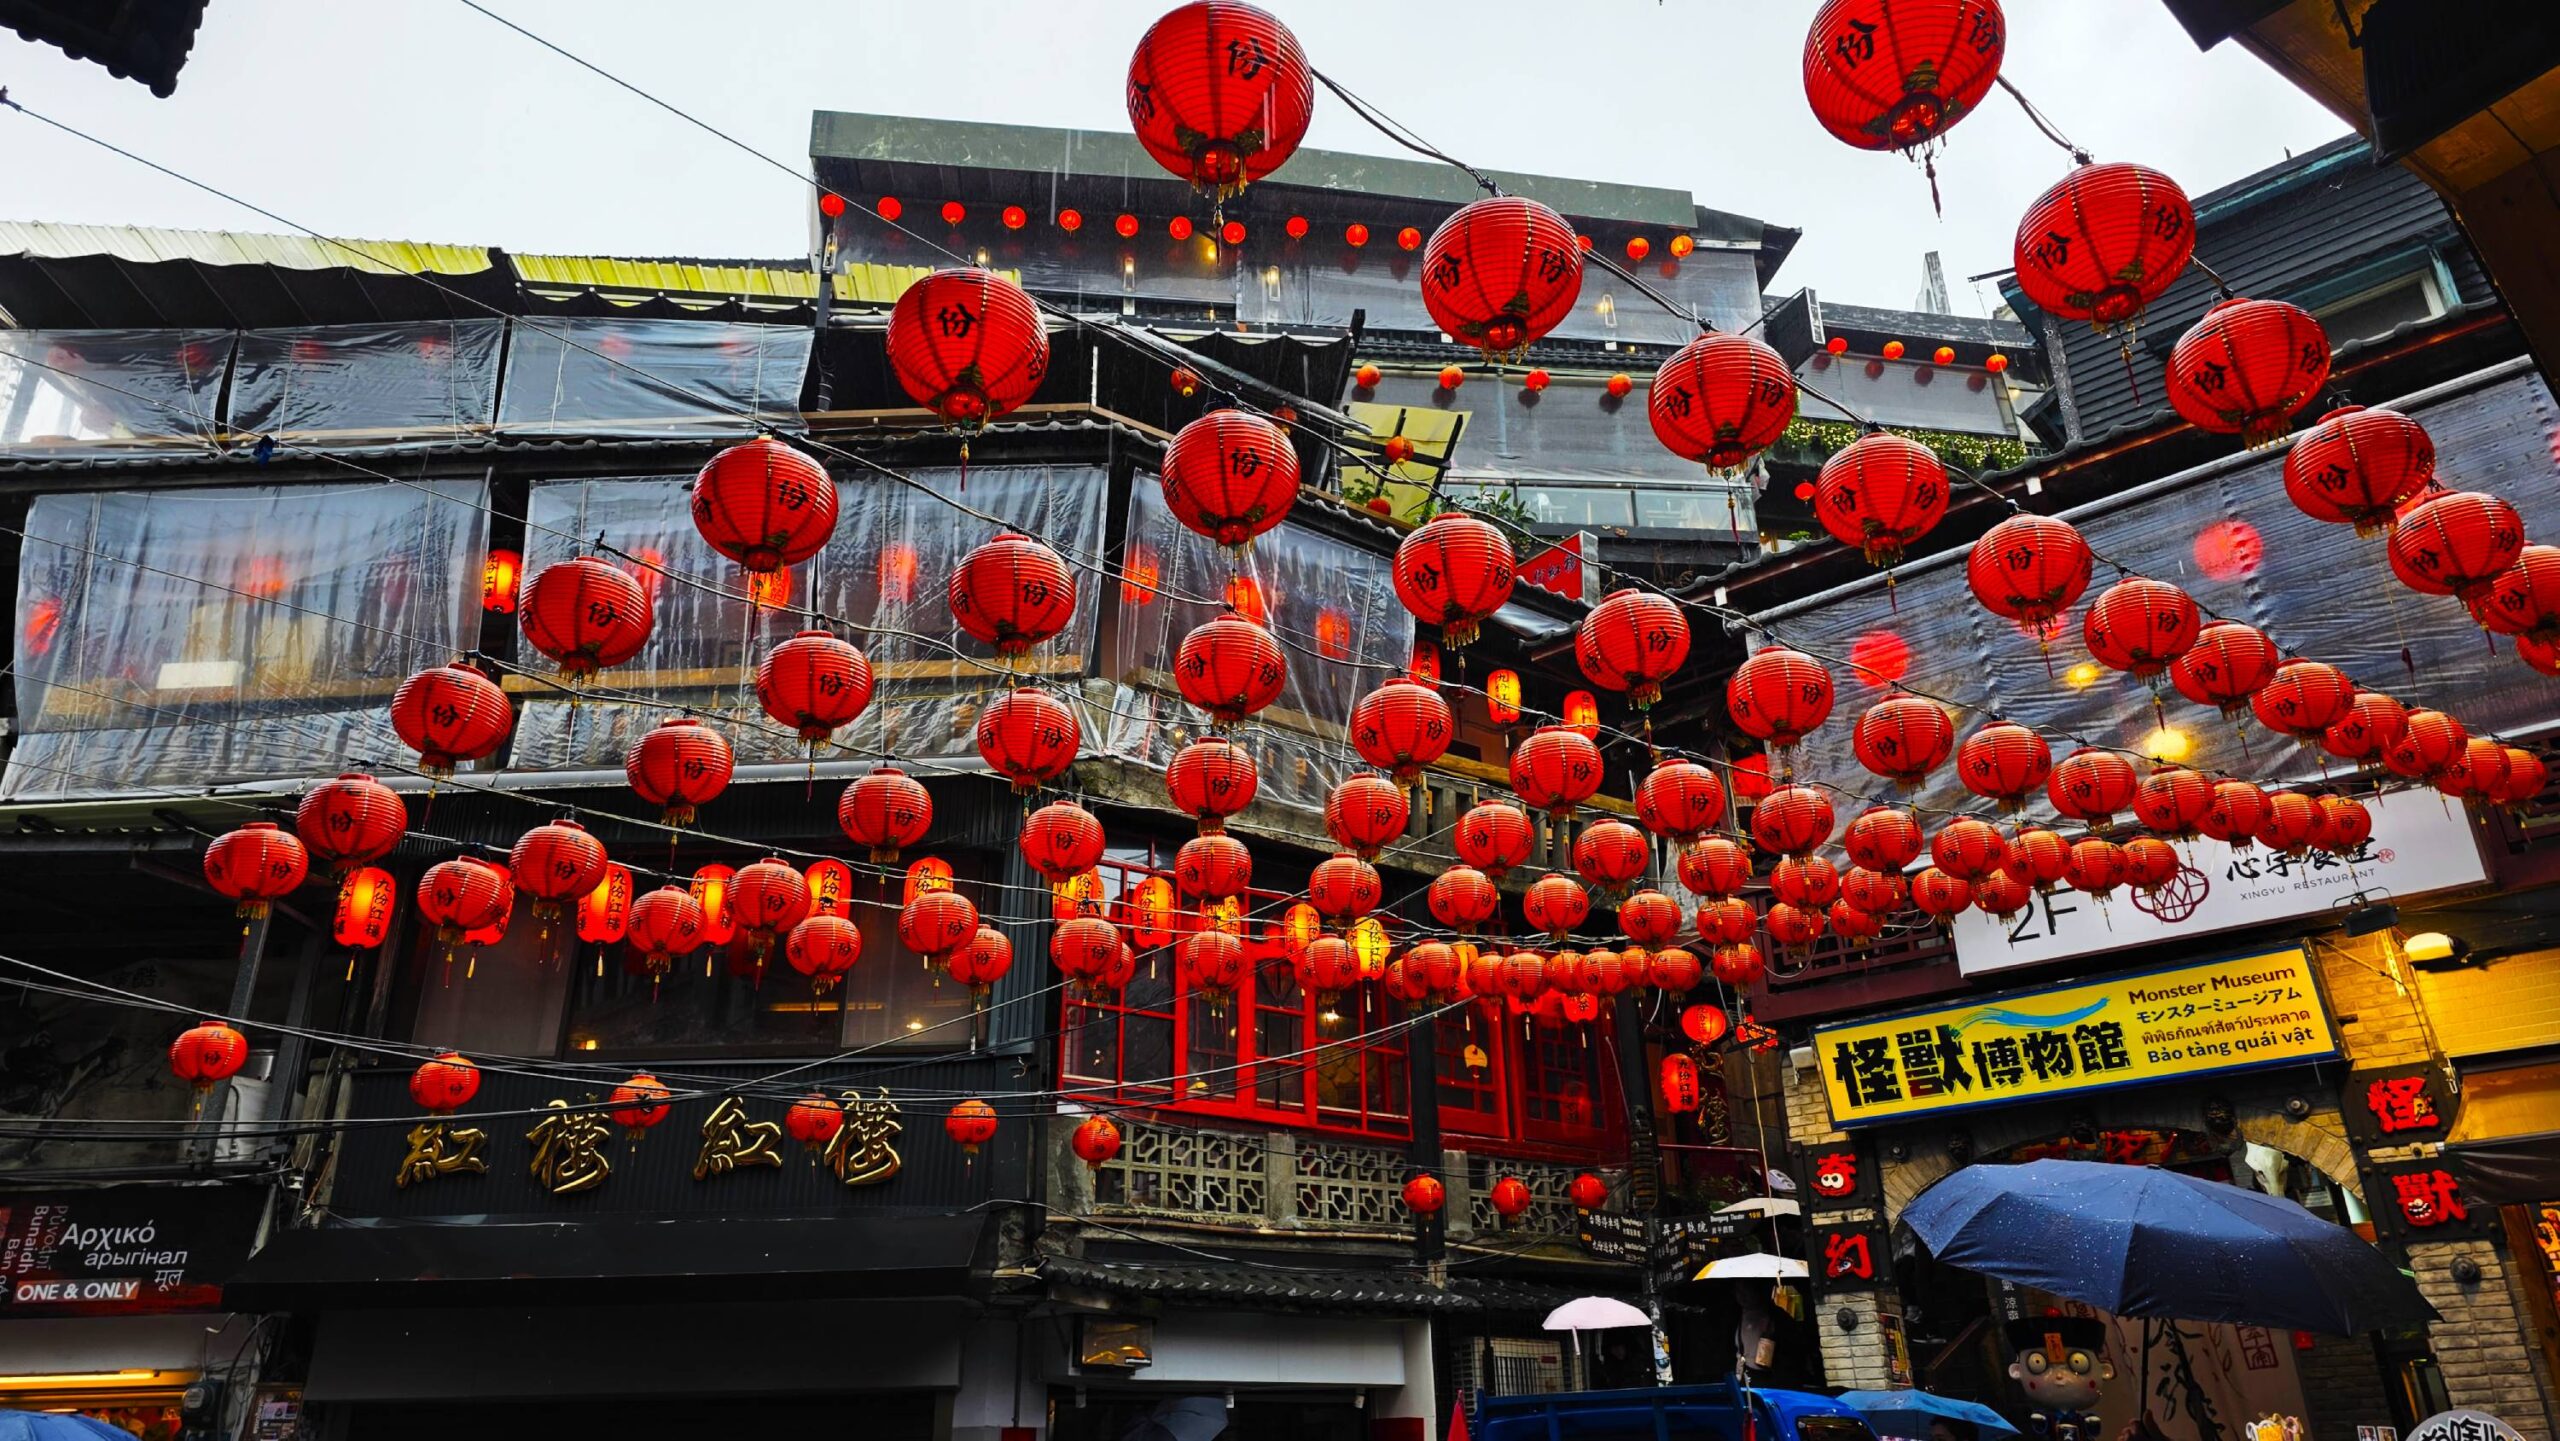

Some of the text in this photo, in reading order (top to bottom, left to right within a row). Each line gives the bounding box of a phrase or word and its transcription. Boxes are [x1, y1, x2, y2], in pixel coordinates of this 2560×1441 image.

[1835, 18, 1878, 70] 份
[1225, 37, 1269, 81] 份
[2153, 203, 2185, 242] 份
[2036, 230, 2071, 271] 份
[1434, 253, 1464, 293] 份
[1537, 248, 1571, 285] 份
[936, 303, 978, 339] 份
[2194, 361, 2228, 395] 份
[1667, 386, 1694, 420] 份
[1762, 379, 1785, 408] 份
[1231, 447, 1262, 478] 份
[2318, 463, 2350, 493] 份
[779, 480, 807, 511] 份
[1834, 484, 1858, 514] 份
[1916, 481, 1939, 509] 份
[2005, 546, 2036, 571] 份
[2413, 547, 2440, 573] 份
[1022, 579, 1049, 606] 份
[1414, 564, 1441, 592] 份
[588, 600, 618, 627] 份
[2501, 588, 2527, 612] 份
[2158, 608, 2180, 633] 份
[1648, 628, 1670, 652] 份
[1184, 654, 1206, 682] 份
[2195, 662, 2217, 682] 份
[820, 673, 844, 695] 份
[1802, 683, 1822, 704] 份
[432, 704, 458, 727] 份
[1427, 719, 1446, 741] 份
[1042, 727, 1063, 748] 份
[1877, 736, 1897, 757] 份
[684, 760, 706, 780] 份
[1211, 776, 1232, 796] 份
[332, 810, 353, 833] 份
[2240, 868, 2376, 901] XINGYU RESTAURANT
[2008, 886, 2078, 944] 2F
[2128, 967, 2297, 1004] Monster Museum
[2136, 987, 2303, 1024] モンスターミュージアム
[2141, 1009, 2311, 1045] พิพิธภัณฑ์สัตว์ประหลาด
[2147, 1026, 2315, 1064] Bảo tàng quái vật
[1833, 1021, 2135, 1108] 怪獸博物館
[2366, 1076, 2469, 1228] 怪獸
[16, 1205, 50, 1275] Bunaidh
[59, 1219, 156, 1251] Αρχικό
[84, 1248, 188, 1270] арыгінал
[16, 1281, 140, 1301] ONE & ONLY
[154, 1269, 185, 1292] मूल
